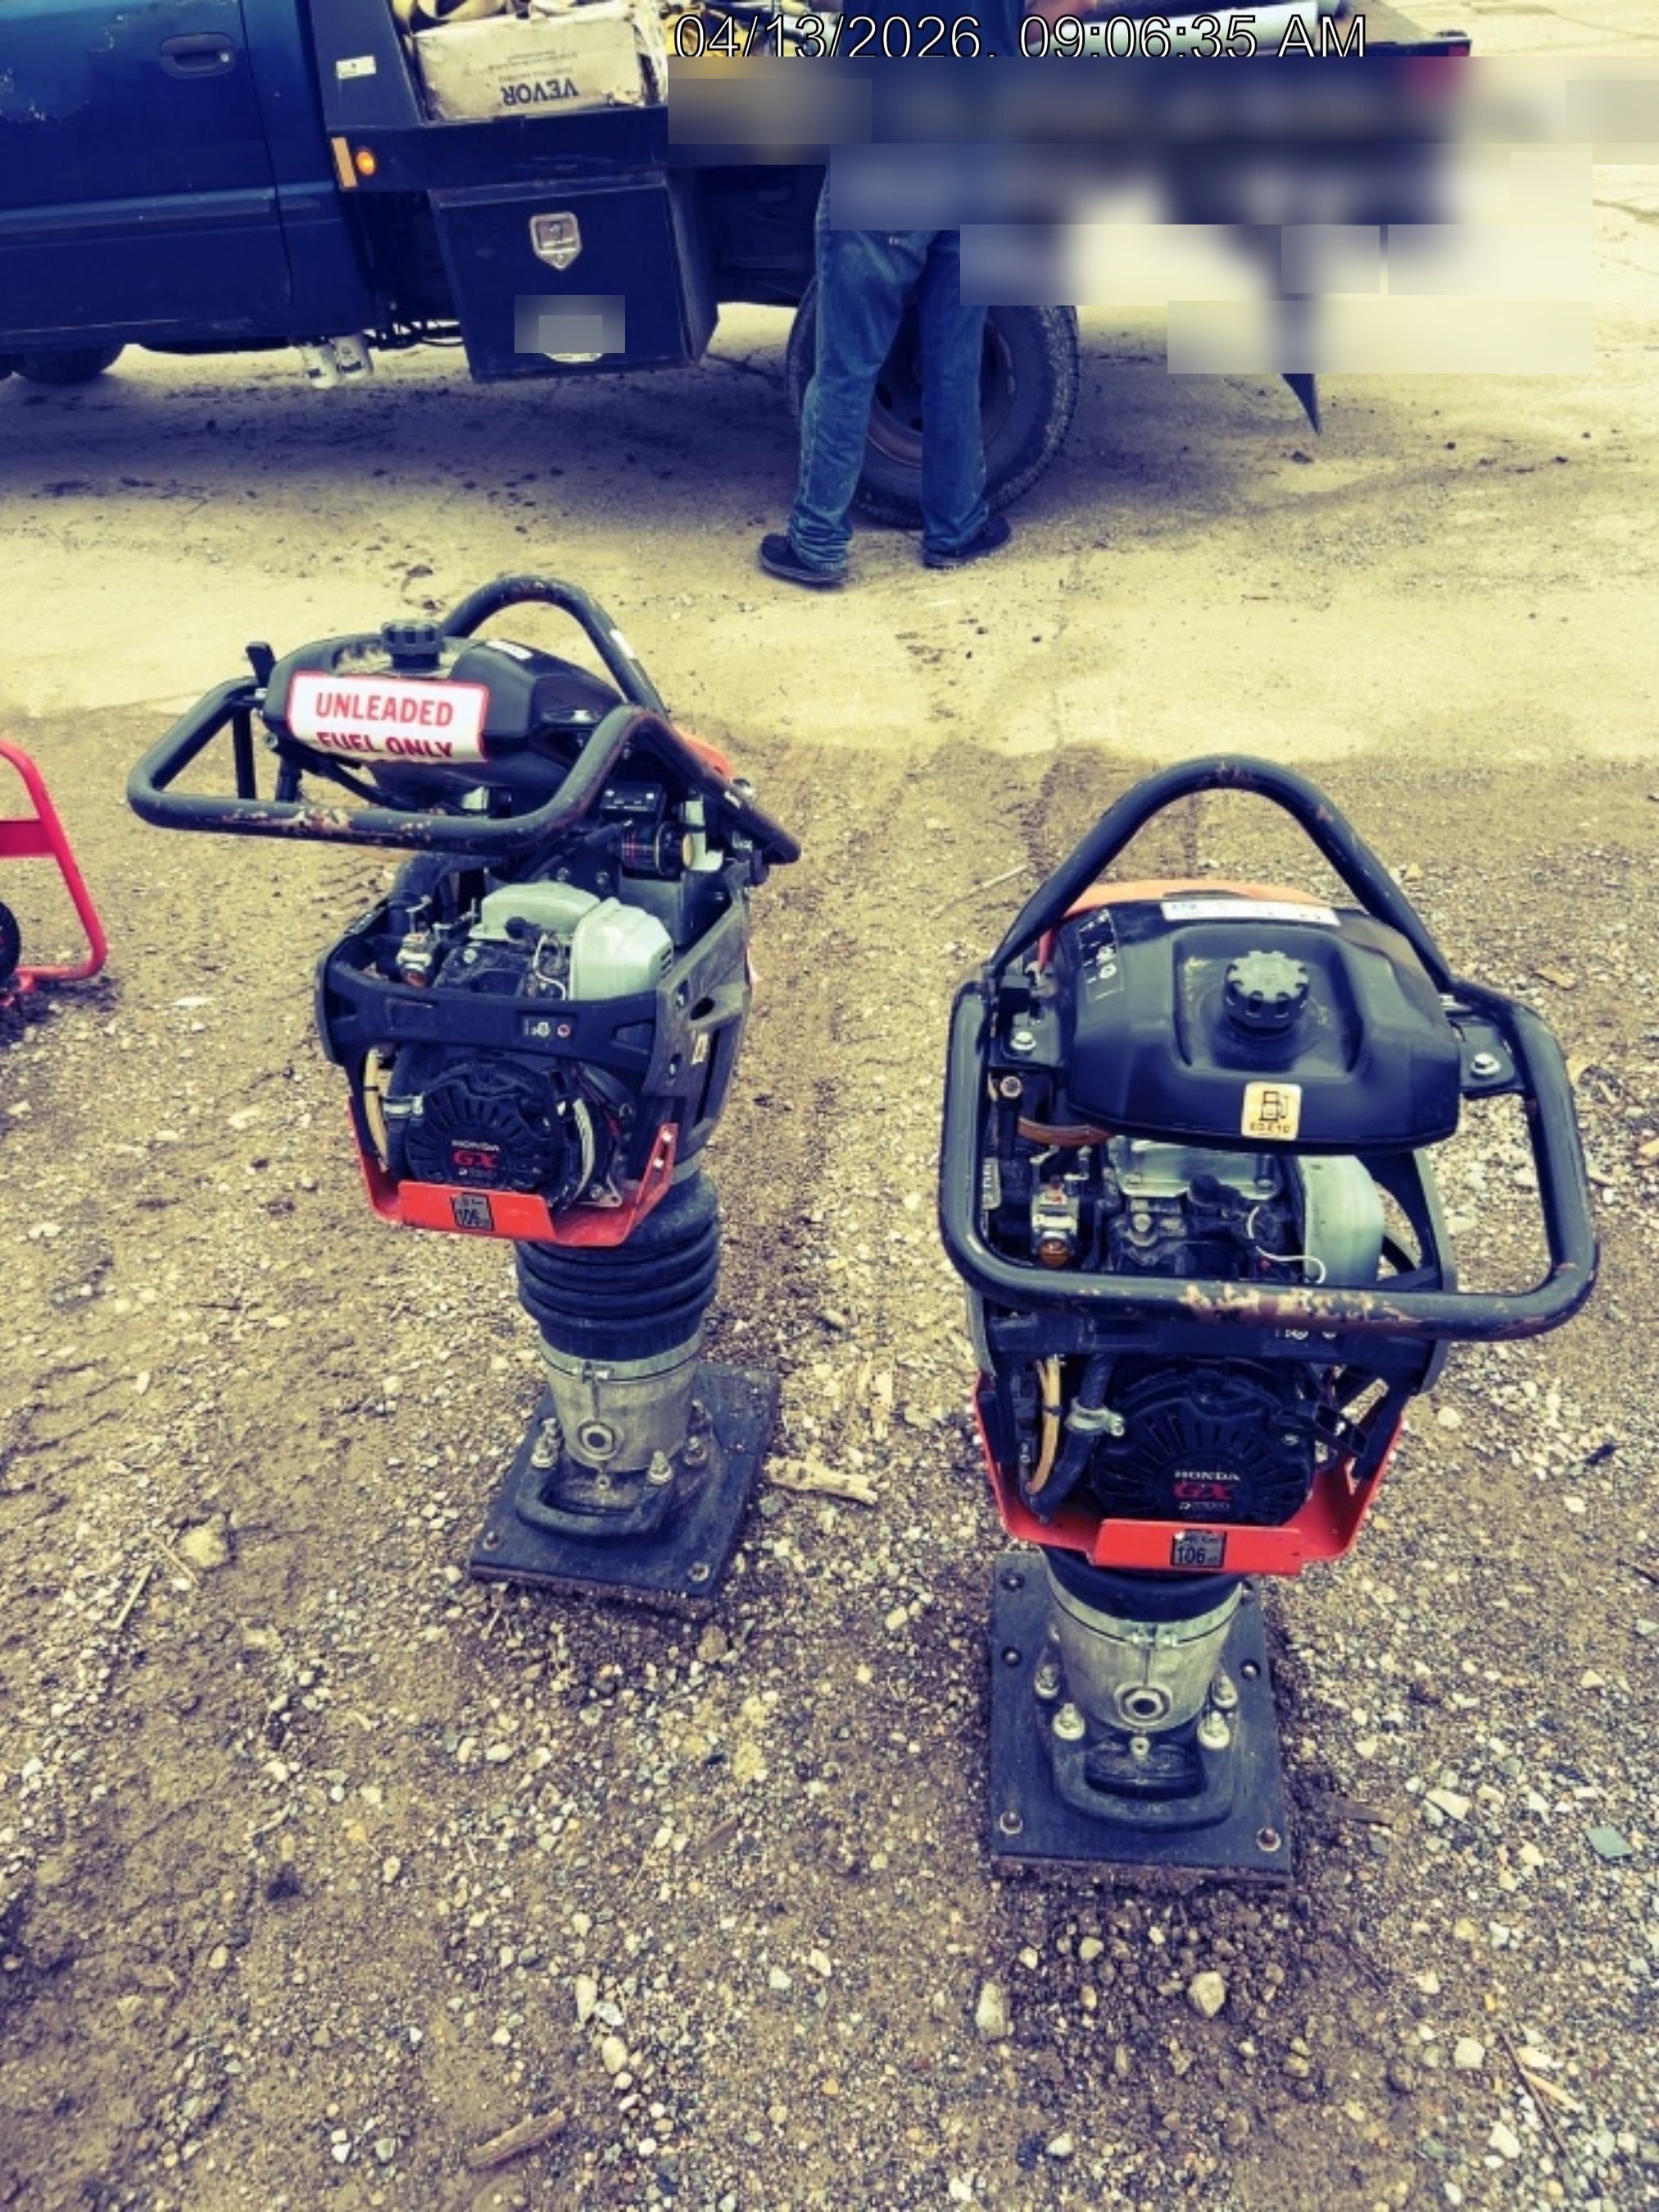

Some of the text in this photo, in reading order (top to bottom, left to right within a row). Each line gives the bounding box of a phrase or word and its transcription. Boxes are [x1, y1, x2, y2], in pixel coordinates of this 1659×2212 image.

[501, 78, 579, 106] VEVOR
[315, 692, 454, 726] UNLEADED
[315, 732, 453, 758] FUEL ONLY
[453, 1149, 498, 1170] GX
[1174, 1470, 1240, 1481] HONDA
[1172, 1480, 1233, 1501] GX
[1176, 1547, 1206, 1564] 106
